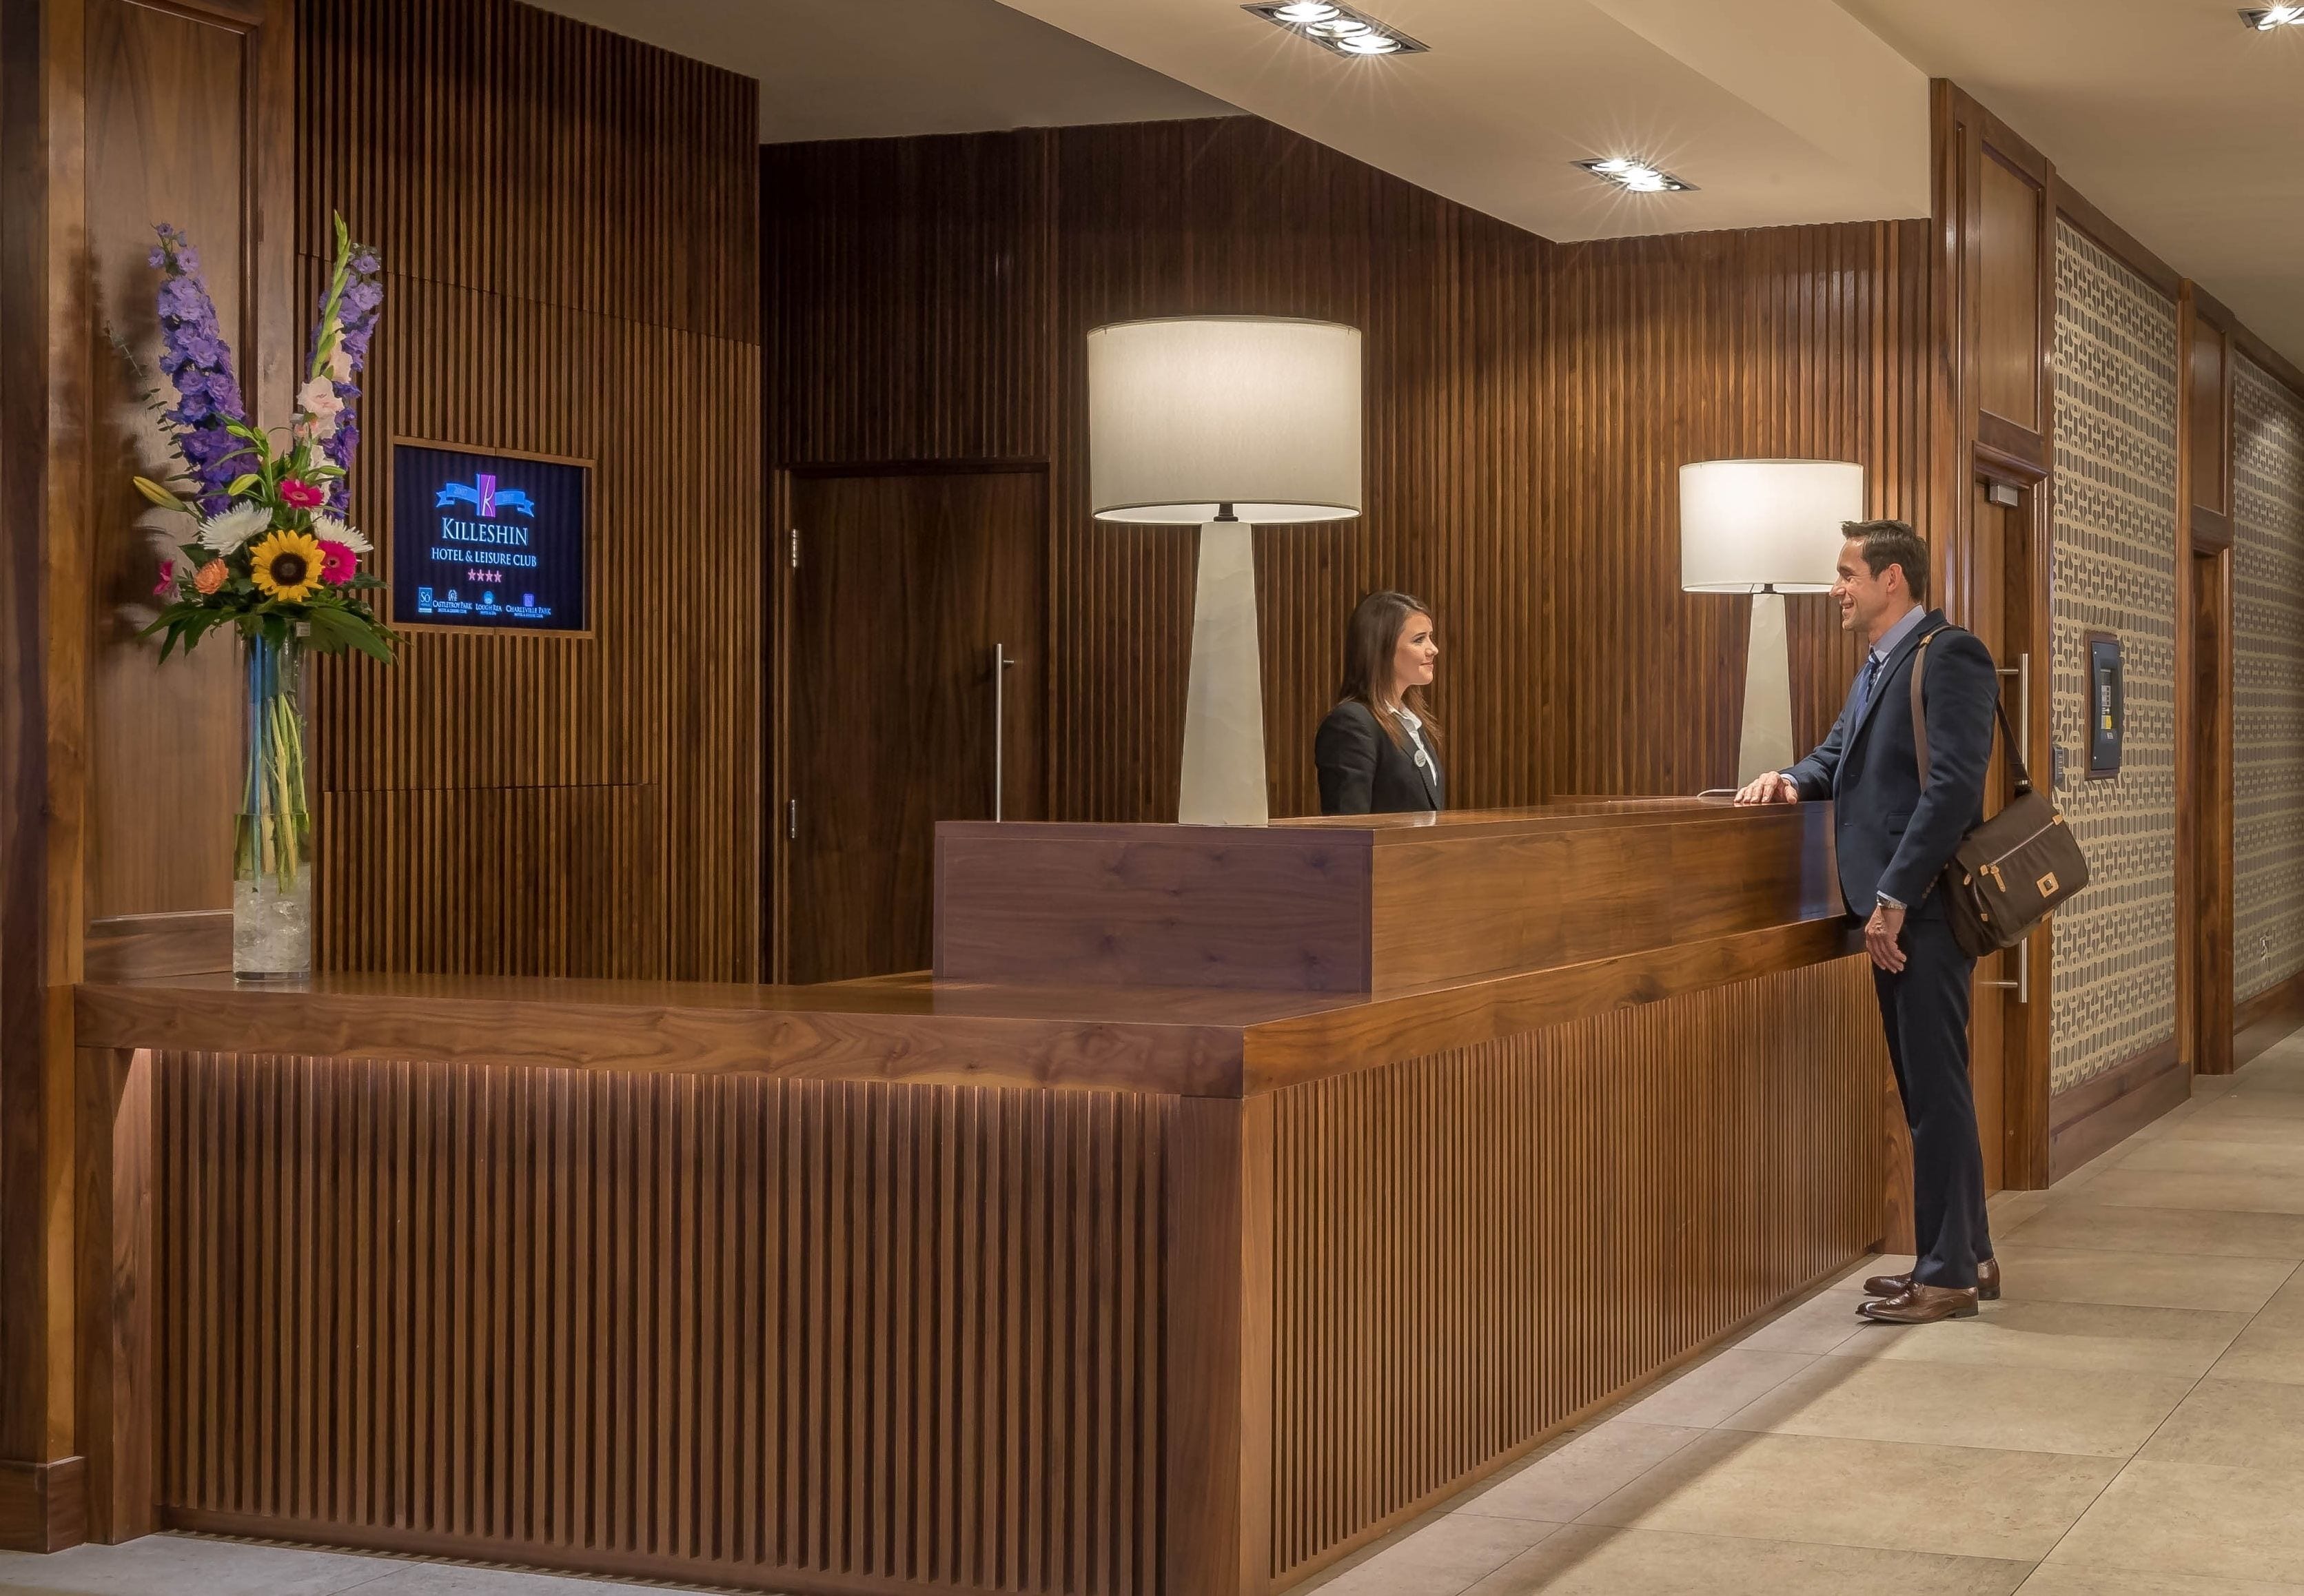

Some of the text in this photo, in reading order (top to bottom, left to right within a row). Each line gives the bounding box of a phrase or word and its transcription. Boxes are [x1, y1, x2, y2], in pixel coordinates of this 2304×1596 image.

[442, 518, 528, 545] KILLESHIN
[431, 548, 537, 567] HOTEL & LEISURE CLUB
